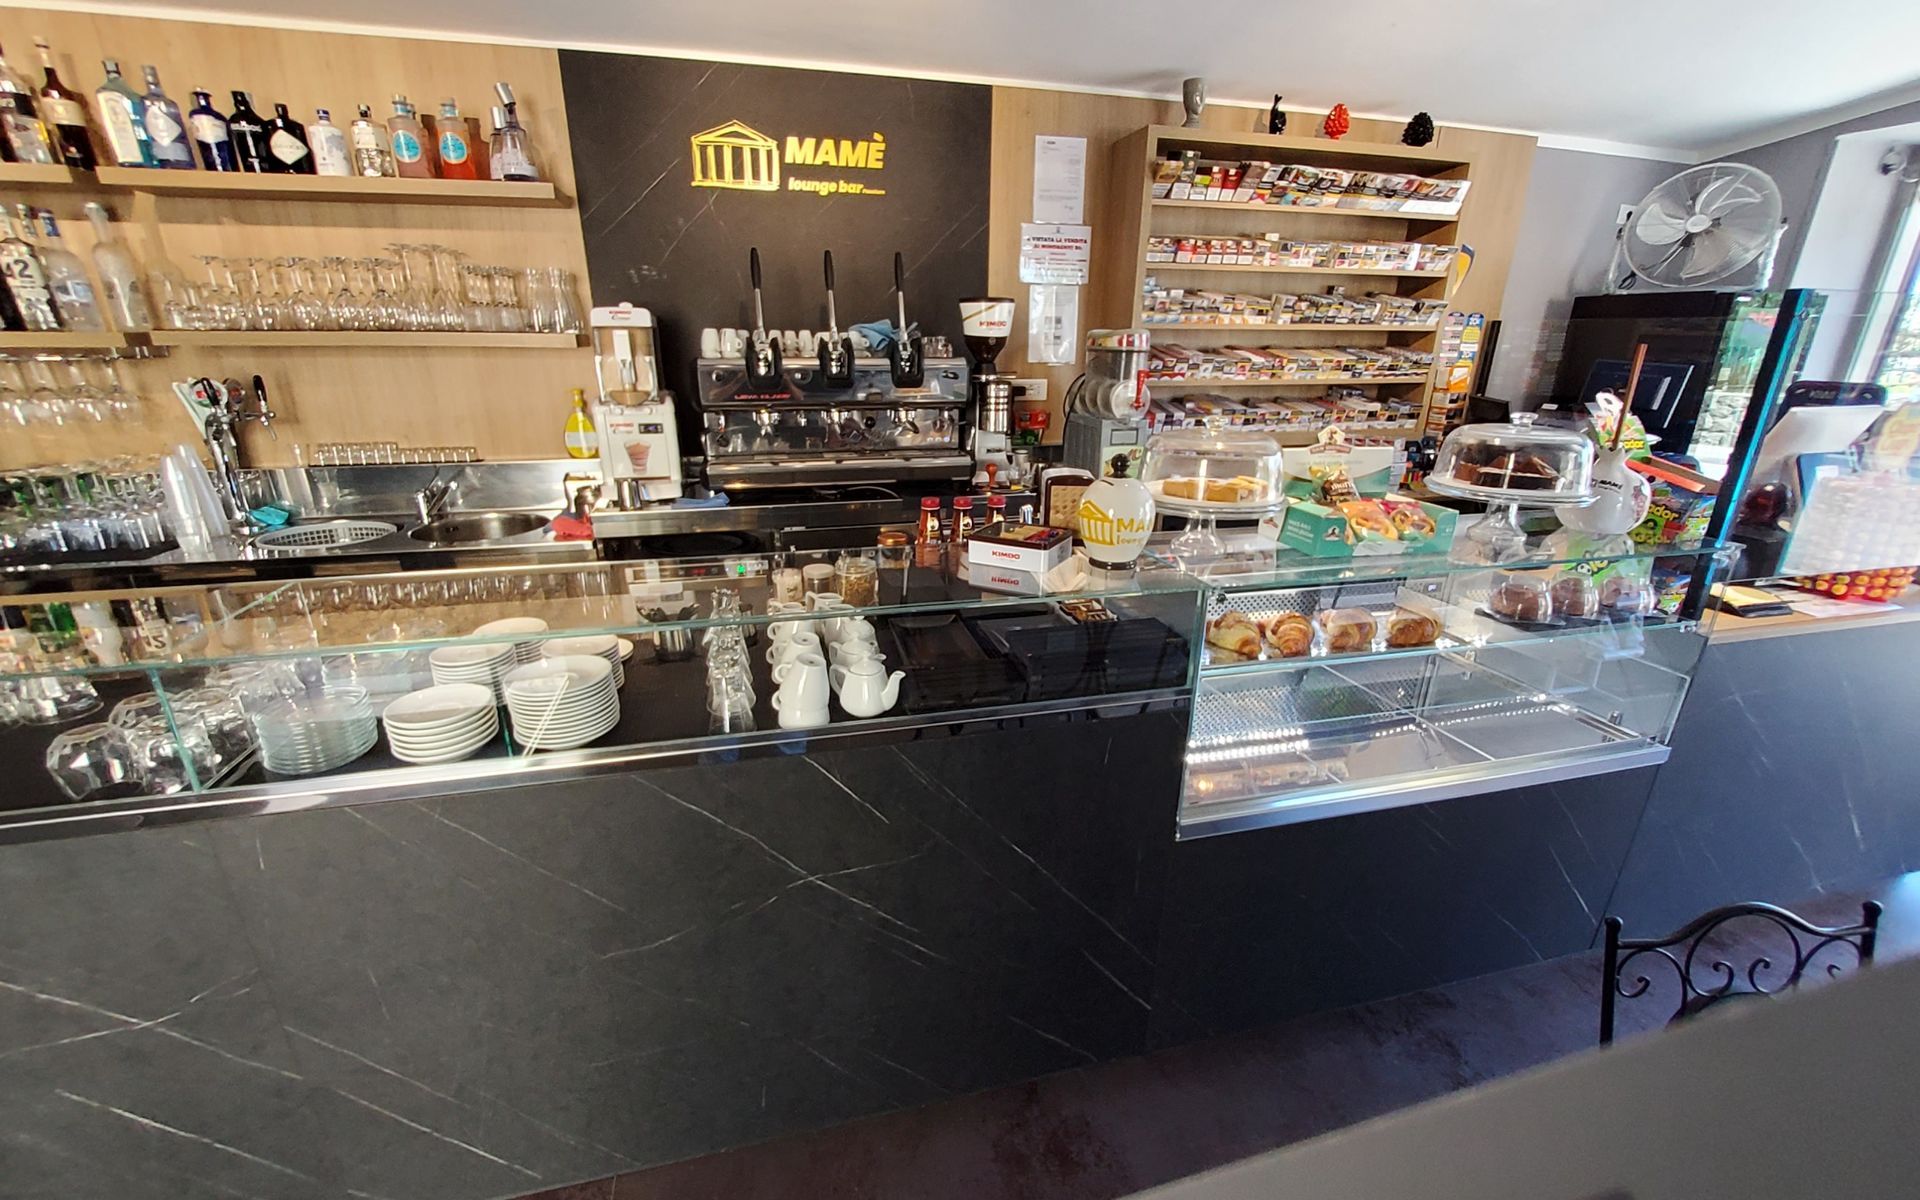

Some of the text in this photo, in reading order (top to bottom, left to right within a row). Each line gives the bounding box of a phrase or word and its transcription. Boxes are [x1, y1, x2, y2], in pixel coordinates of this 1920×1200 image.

[784, 132, 886, 169] MAMÈ
[788, 177, 837, 196] lounge
[838, 180, 864, 194] bar
[1117, 518, 1149, 533] MA
